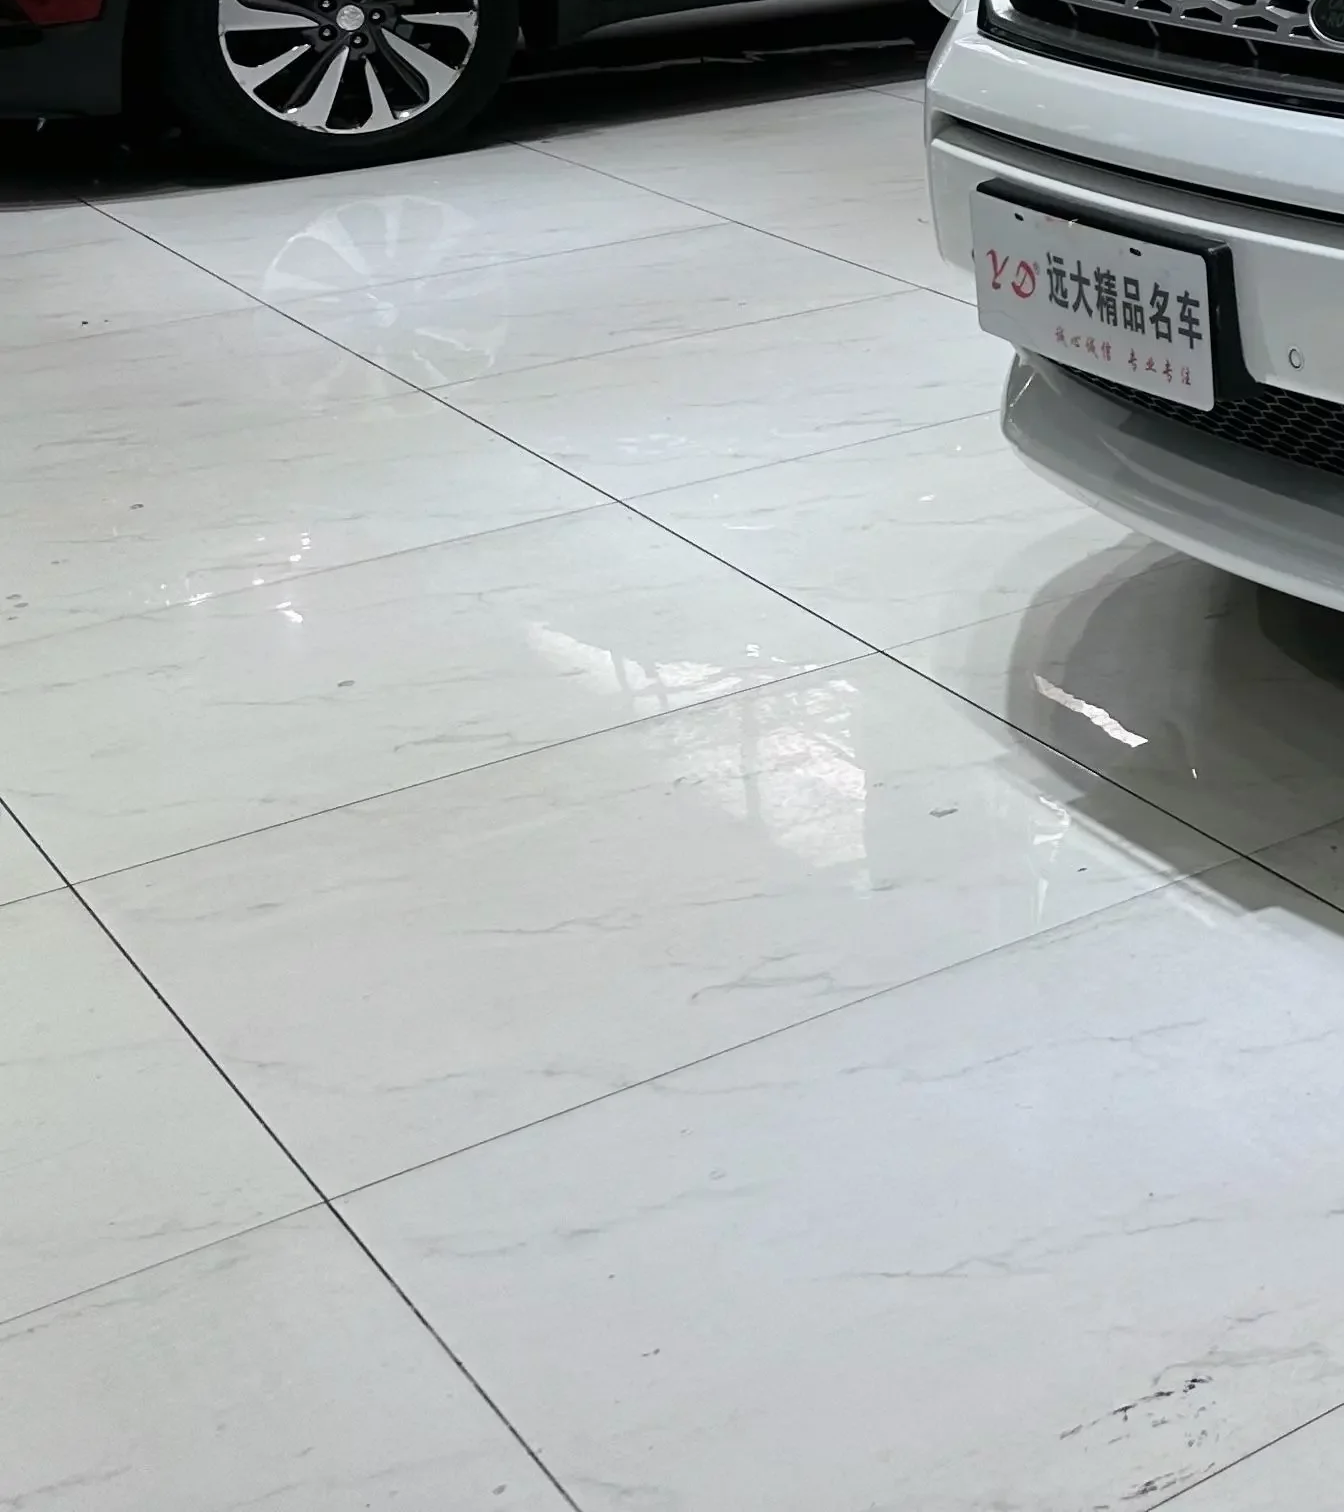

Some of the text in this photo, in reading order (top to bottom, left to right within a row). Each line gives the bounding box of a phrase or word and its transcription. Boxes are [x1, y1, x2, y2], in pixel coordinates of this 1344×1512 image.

[1046, 251, 1203, 349] 远大精品名车
